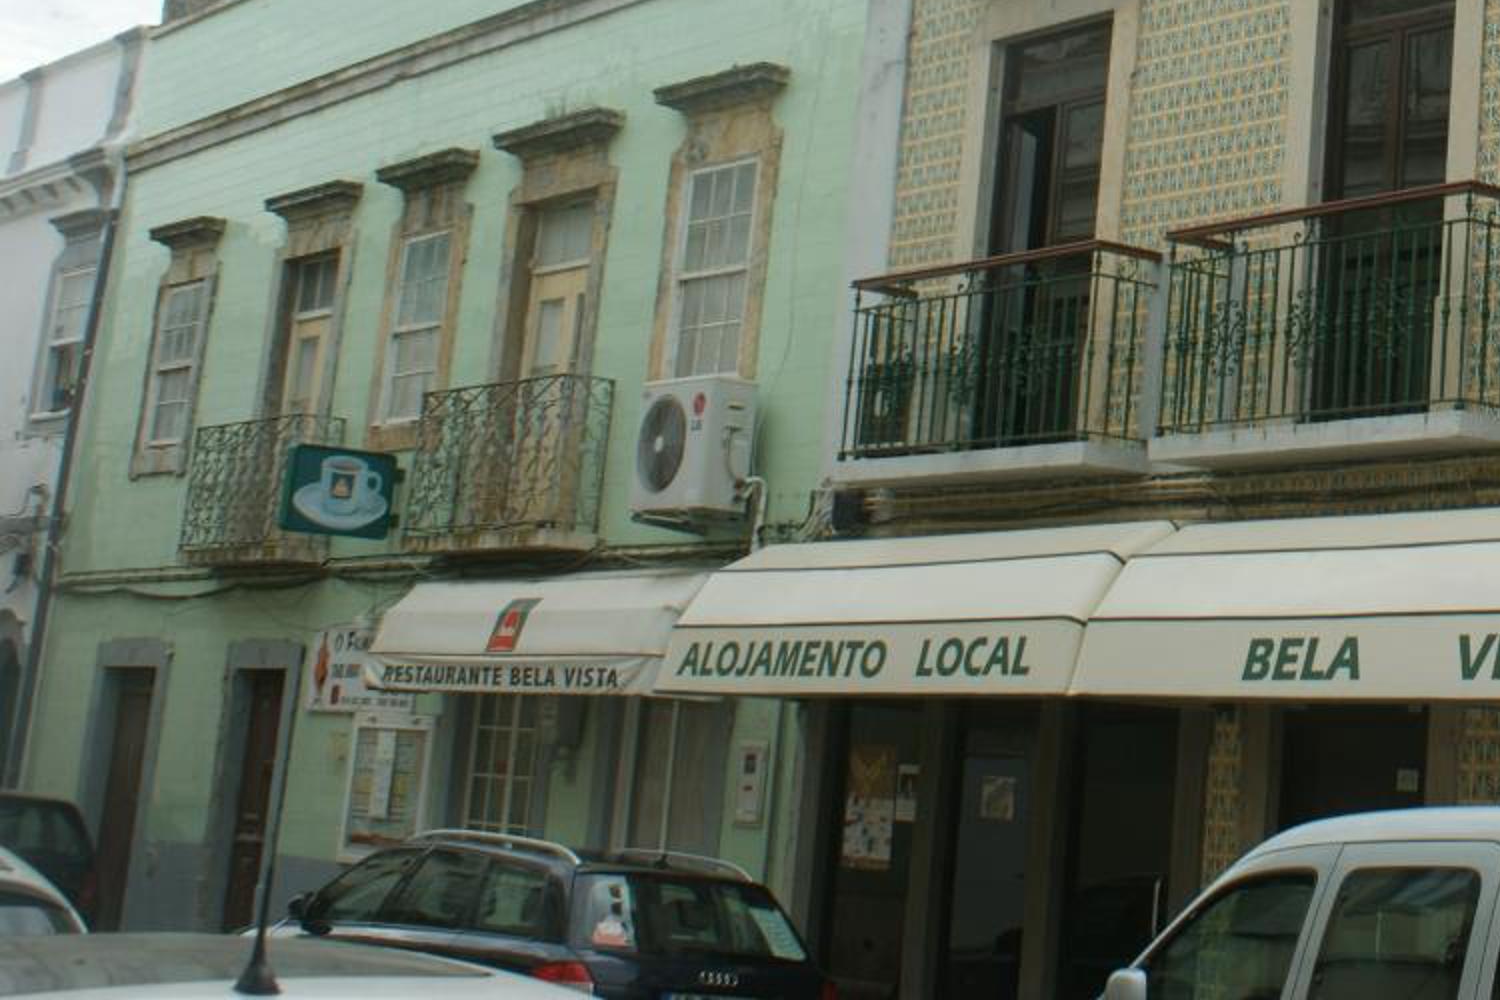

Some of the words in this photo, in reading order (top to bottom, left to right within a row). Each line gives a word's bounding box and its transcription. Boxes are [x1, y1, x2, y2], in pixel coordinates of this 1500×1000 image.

[383, 663, 503, 686] RESTAURANTE
[509, 666, 556, 688] BELA
[564, 667, 619, 689] VISTA
[675, 639, 888, 679] ALOJAMENTO
[915, 635, 1032, 678] LOCAL
[1241, 636, 1361, 681] BELA
